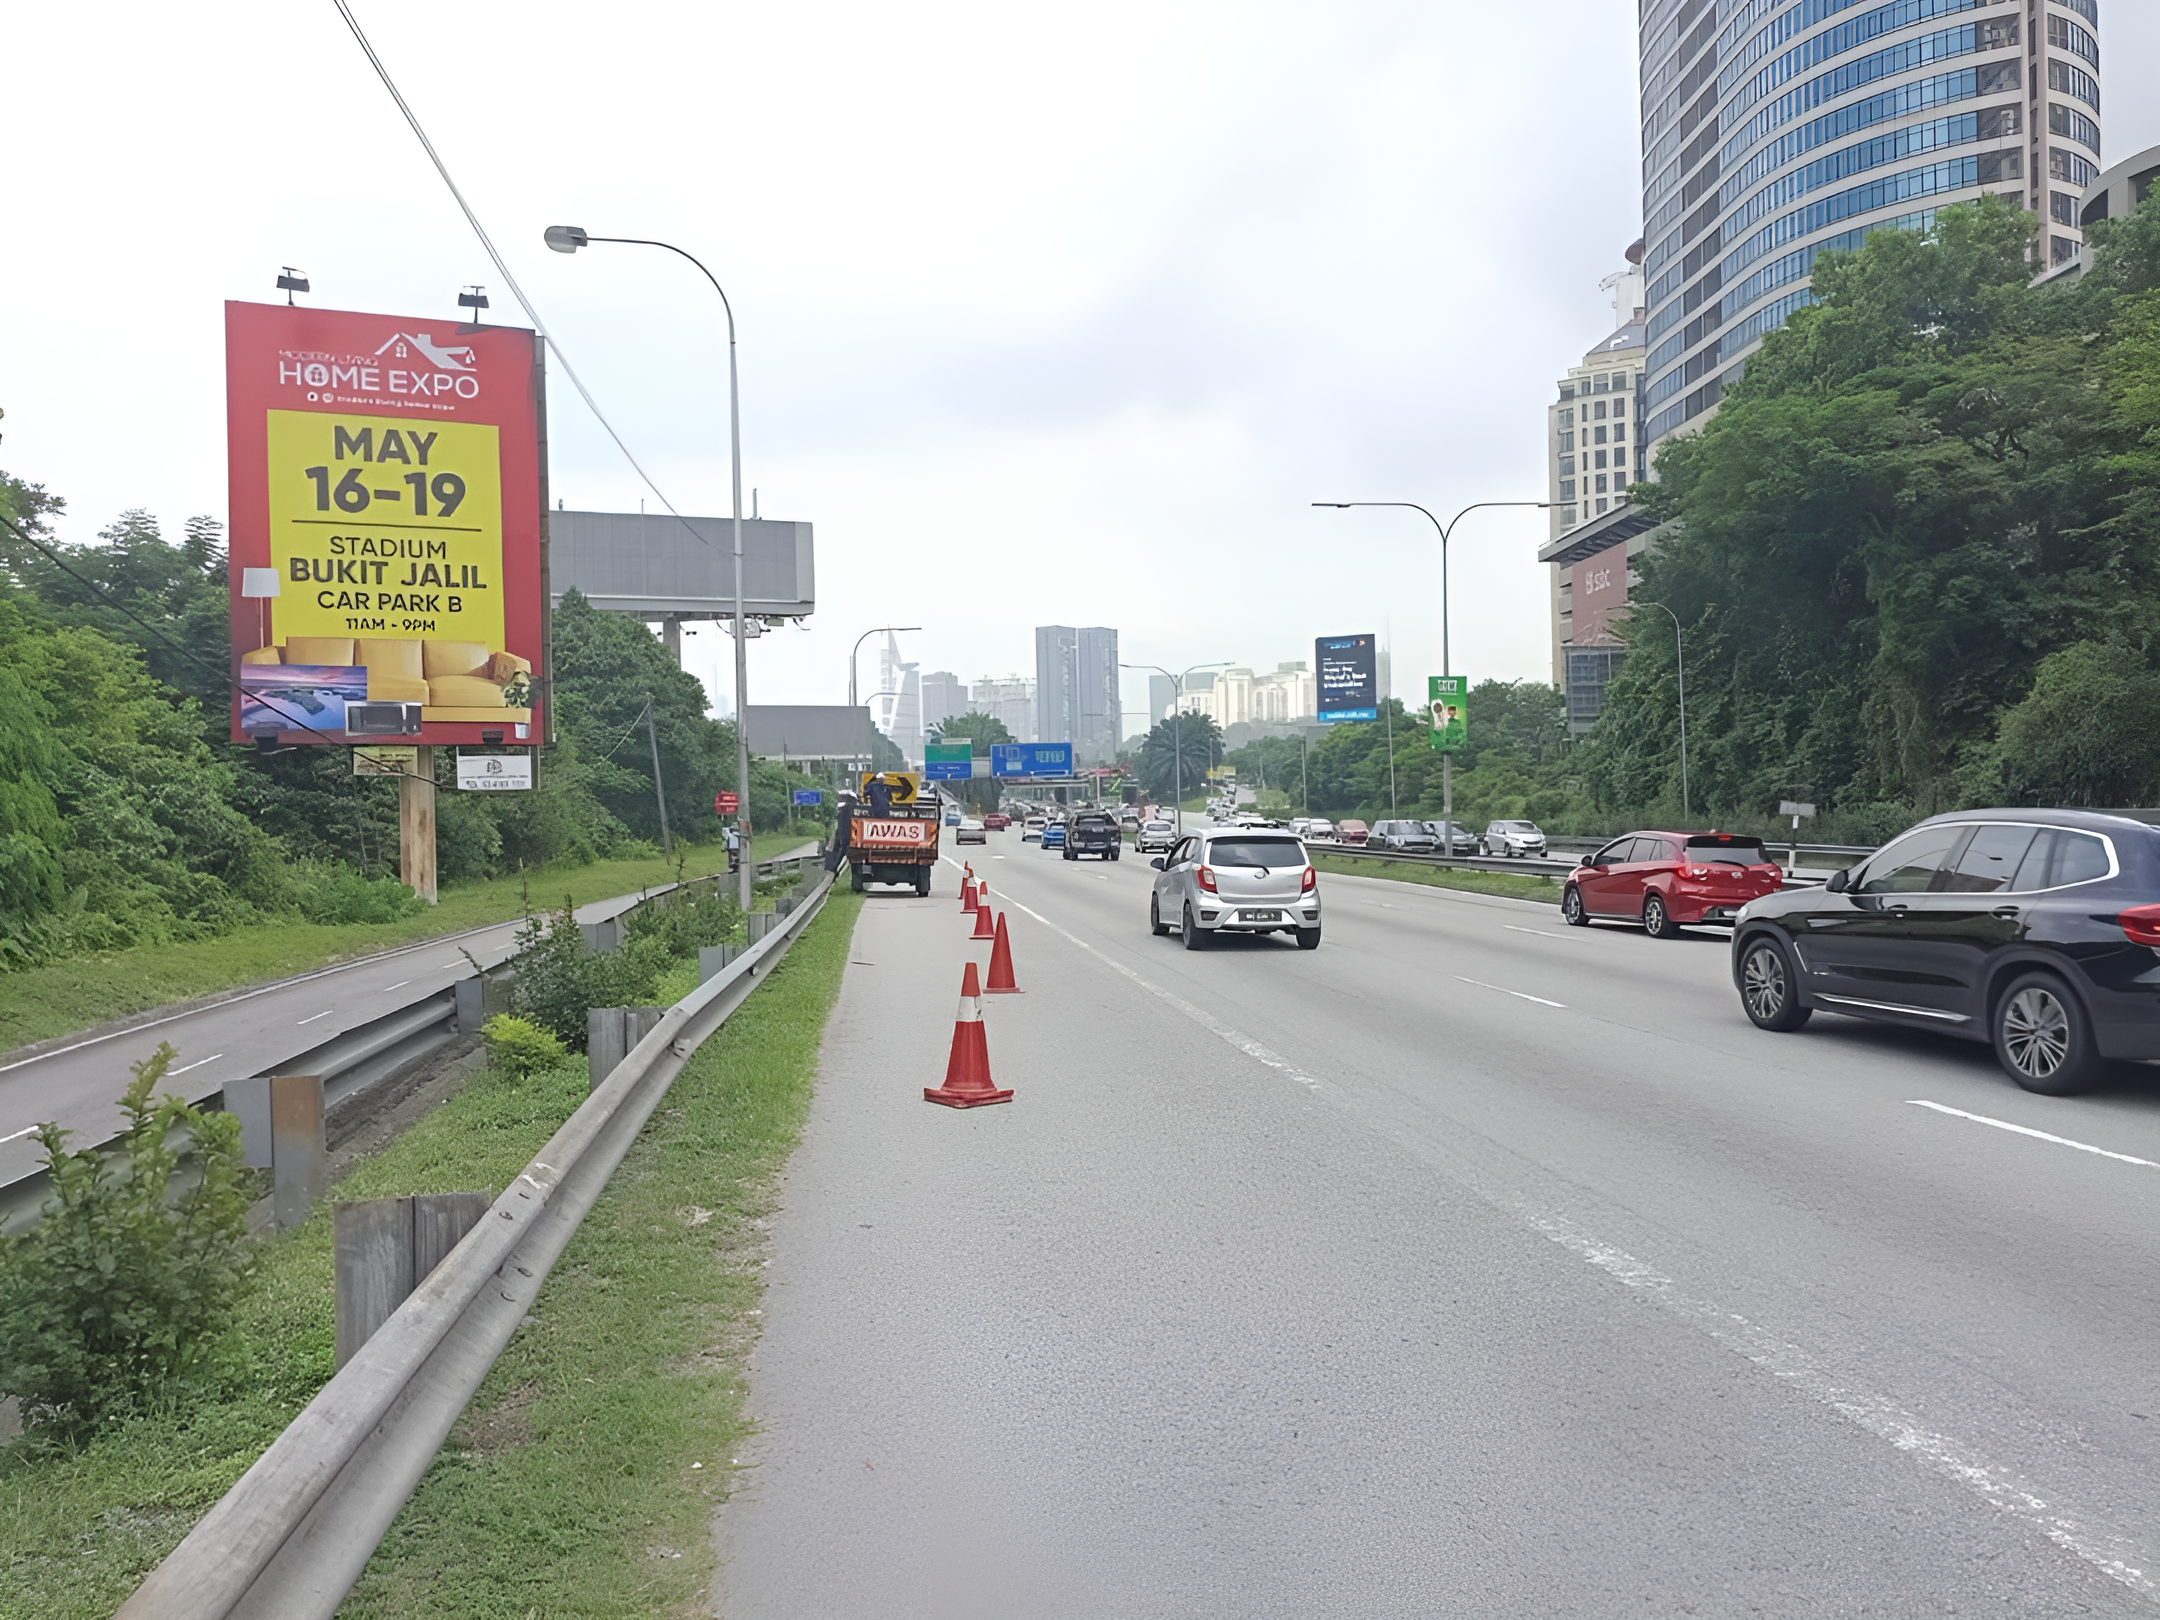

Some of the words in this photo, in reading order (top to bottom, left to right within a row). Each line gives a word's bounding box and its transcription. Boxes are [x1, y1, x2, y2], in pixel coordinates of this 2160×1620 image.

[280, 360, 380, 390] HOME
[389, 371, 479, 398] EXPO
[334, 425, 438, 465] MAY
[329, 536, 446, 559] STADIUM
[290, 557, 388, 585] BUKIT
[400, 562, 487, 589] JALIL
[317, 591, 370, 610] CAR
[378, 593, 440, 612] PARK
[448, 595, 462, 612] B
[346, 618, 385, 630] 11AM
[402, 619, 436, 631] 9PM
[869, 825, 920, 839] AWAS
